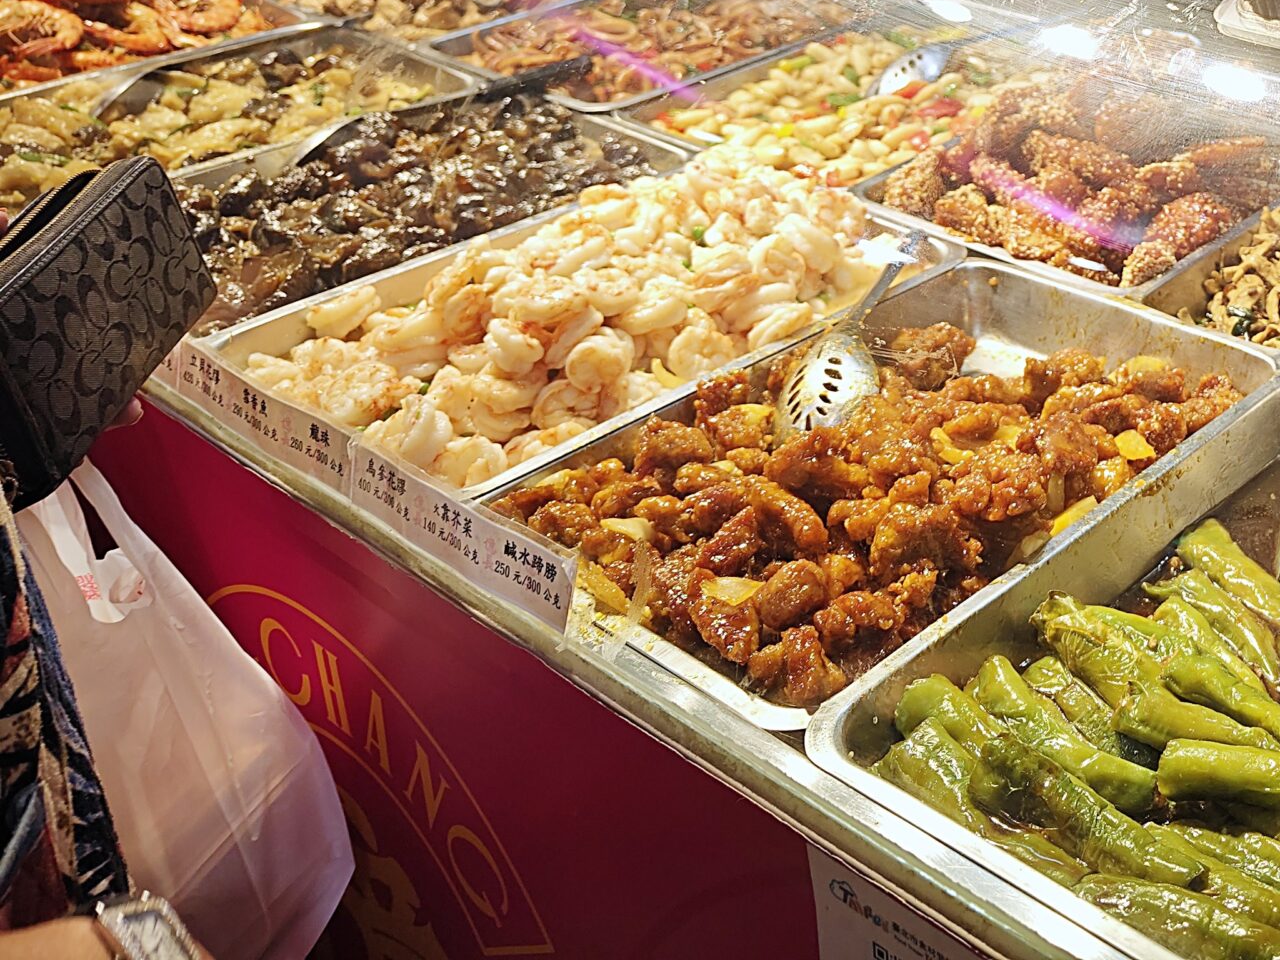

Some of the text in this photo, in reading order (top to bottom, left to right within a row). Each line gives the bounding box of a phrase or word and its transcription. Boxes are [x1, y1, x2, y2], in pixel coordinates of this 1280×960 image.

[263, 425, 279, 442] 公克
[330, 458, 344, 477] 公克
[396, 502, 410, 523] 公克
[423, 516, 437, 535] 140
[437, 528, 462, 553] 元/300
[463, 544, 480, 566] 公克
[494, 559, 561, 610] 250 元/300 公克
[260, 618, 508, 928] CHANG
